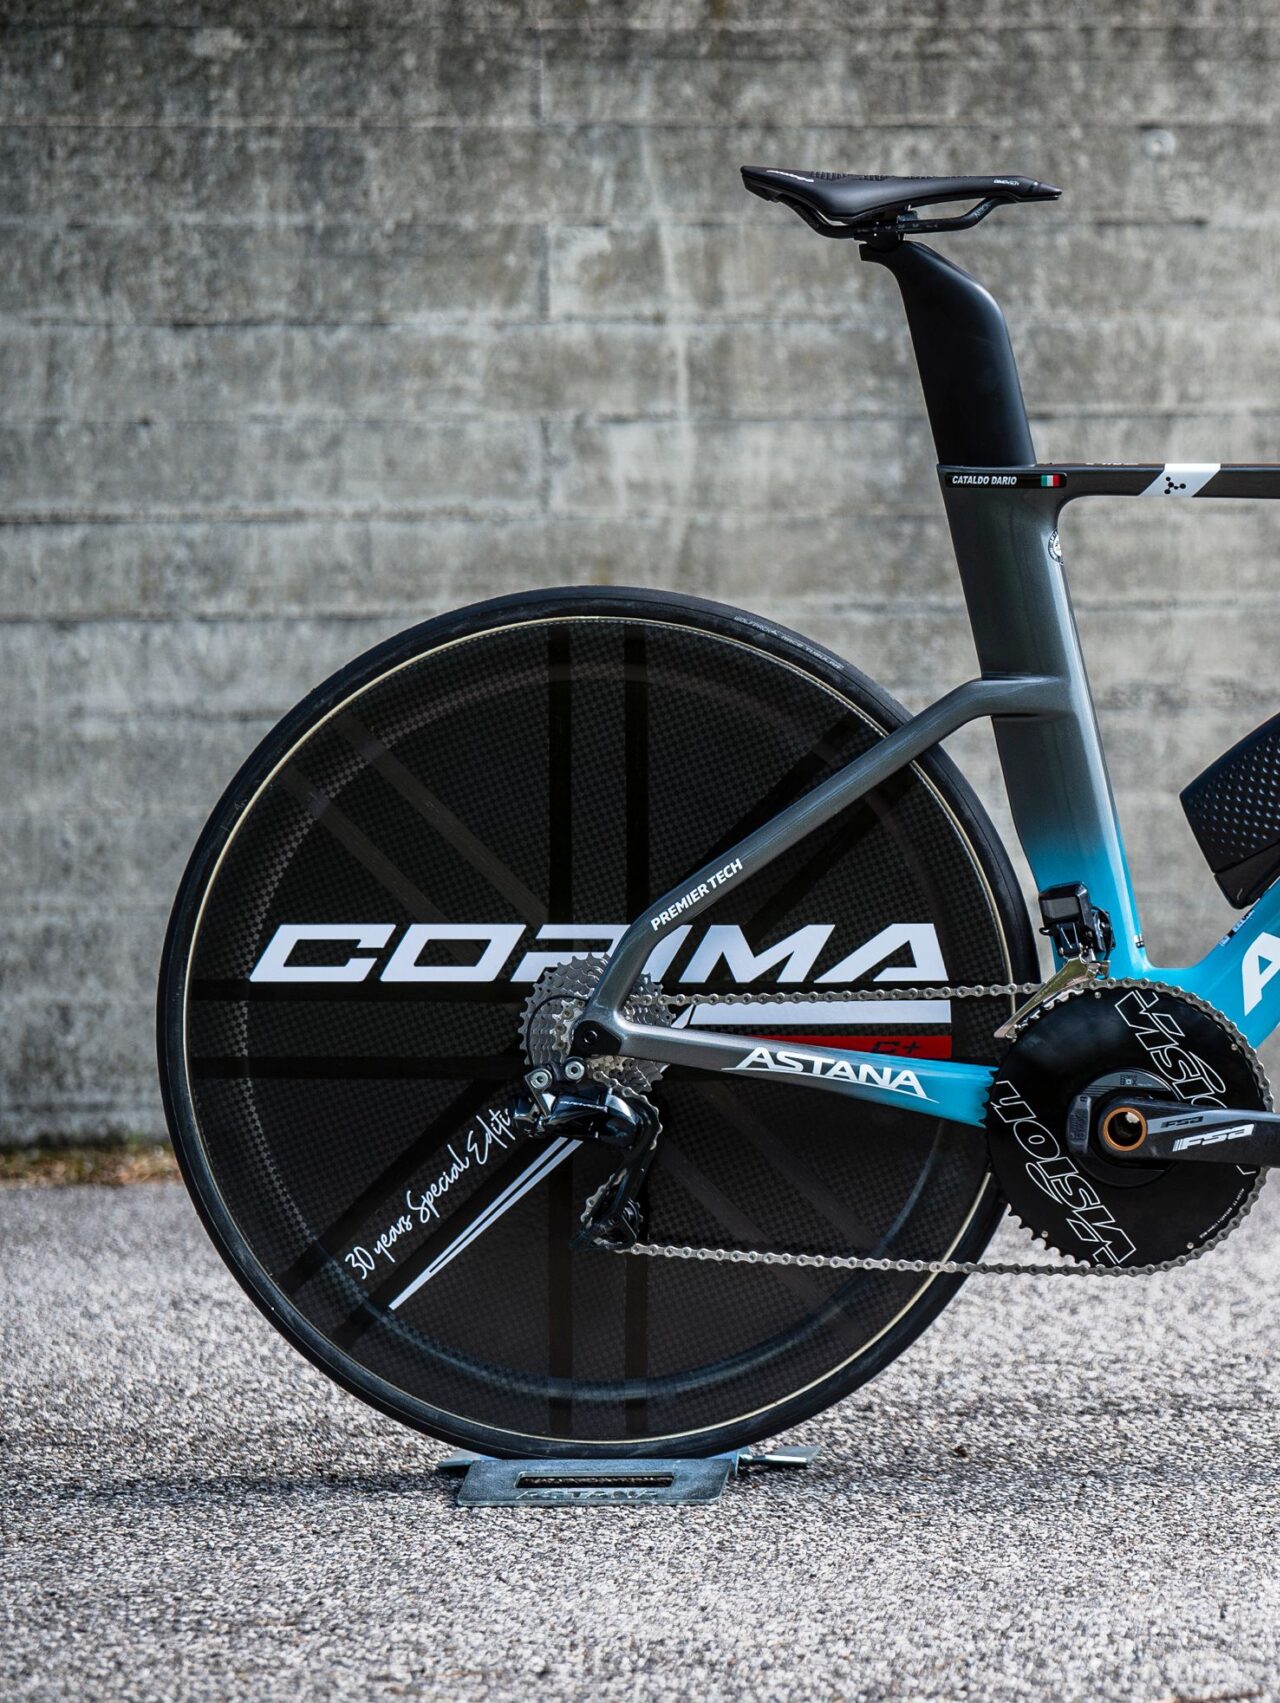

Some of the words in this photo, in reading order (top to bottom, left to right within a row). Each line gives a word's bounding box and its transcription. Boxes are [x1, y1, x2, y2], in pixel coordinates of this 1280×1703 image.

[952, 475, 990, 486] CATALDO
[991, 475, 1017, 486] DARIO
[650, 883, 710, 931] PREMIER
[706, 858, 744, 889] TECH
[734, 1047, 930, 1100] ASTANA
[345, 1246, 375, 1280] 30
[373, 1215, 413, 1263] years
[406, 1144, 470, 1223] Special
